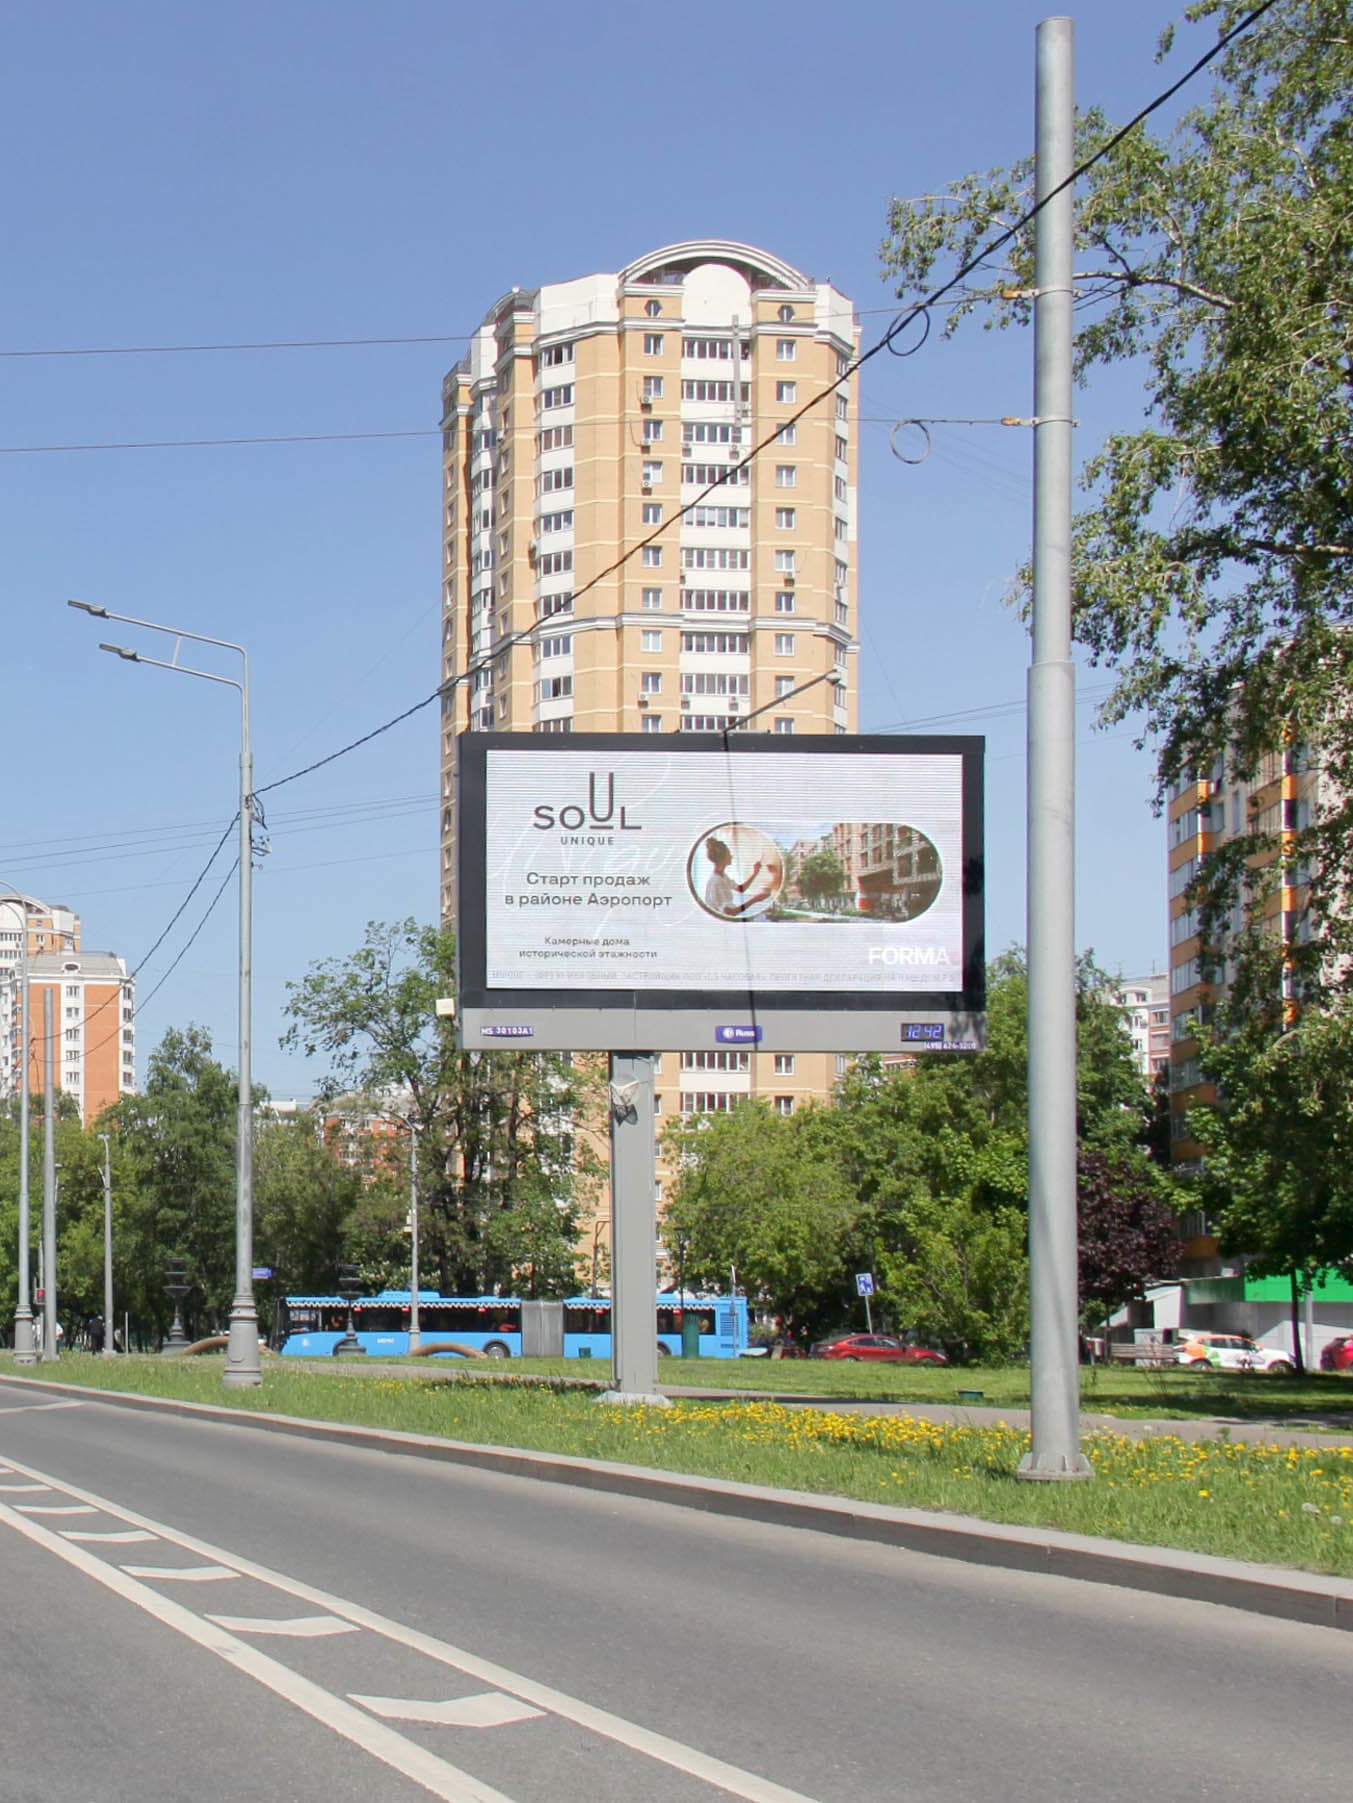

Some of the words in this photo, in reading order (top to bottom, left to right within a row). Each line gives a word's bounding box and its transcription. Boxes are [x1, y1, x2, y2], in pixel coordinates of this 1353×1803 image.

[533, 772, 642, 830] SOUL
[560, 836, 614, 846] UNIQUE
[526, 872, 579, 888] Старт
[583, 876, 650, 888] продаж
[505, 895, 514, 905] в
[519, 893, 583, 907] районе
[587, 893, 672, 908] Аэропорт
[545, 936, 599, 946] Камерные
[601, 938, 630, 946] дома
[519, 949, 596, 958] исторической
[869, 948, 950, 965] FORMA
